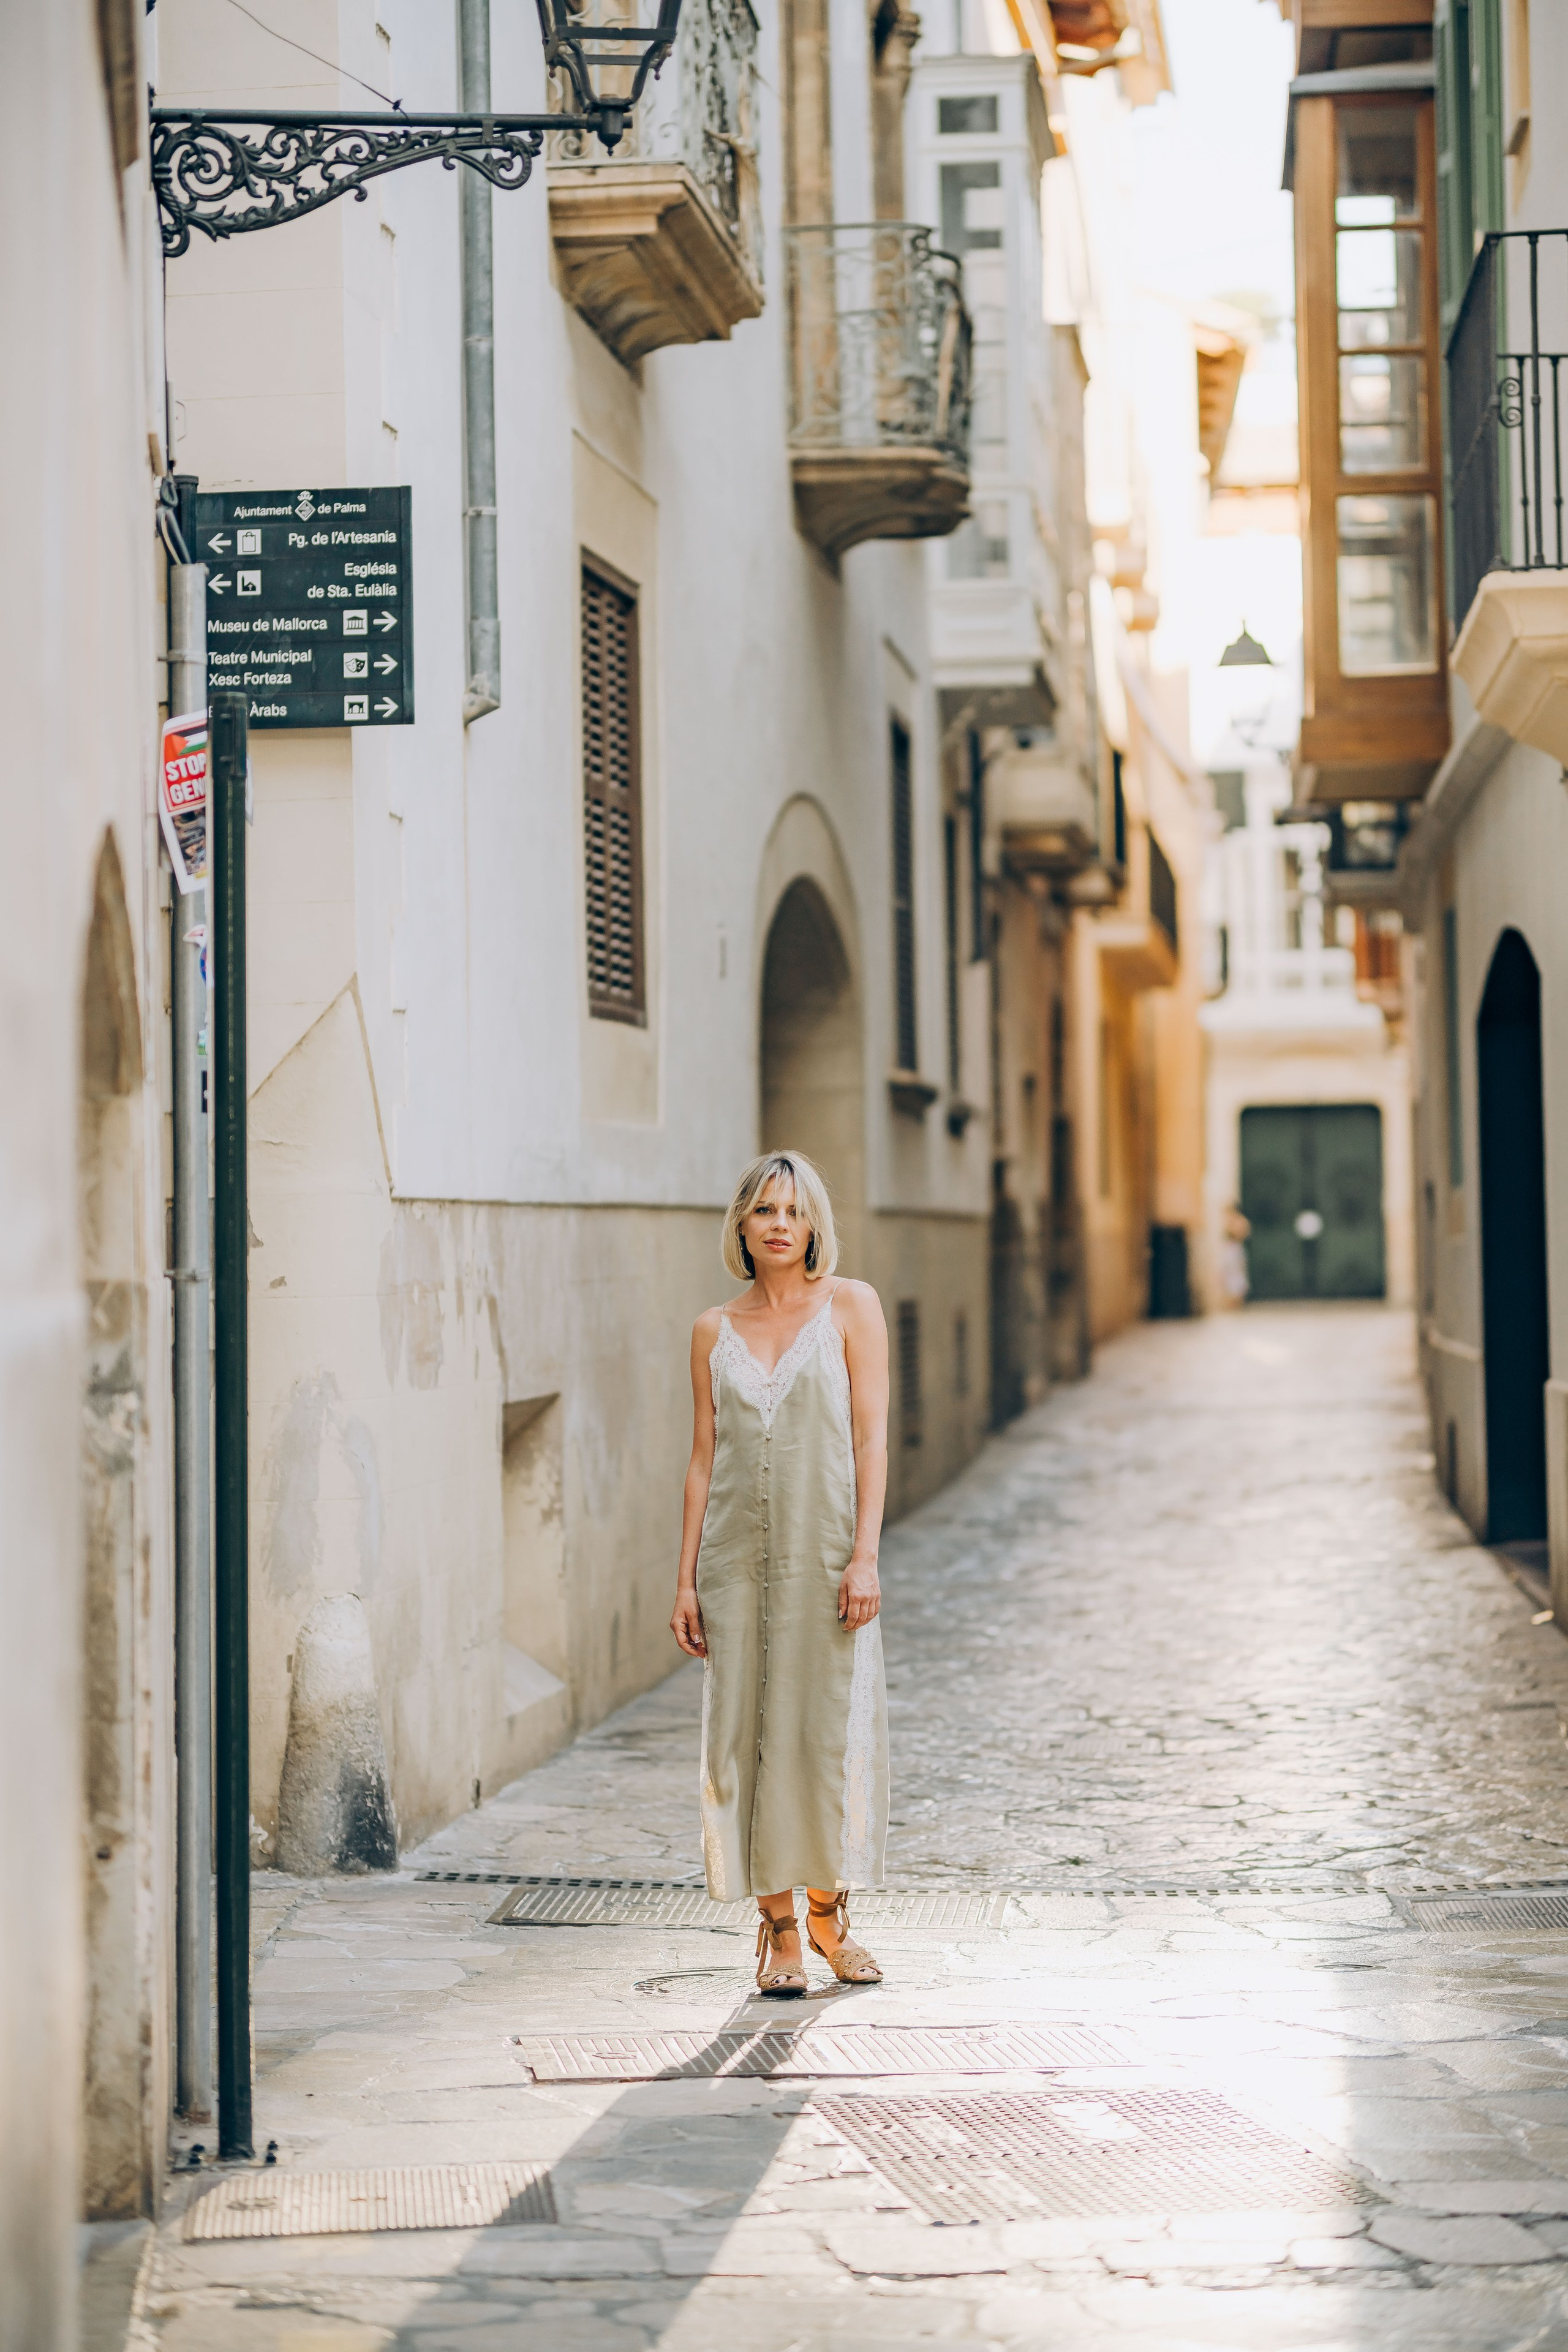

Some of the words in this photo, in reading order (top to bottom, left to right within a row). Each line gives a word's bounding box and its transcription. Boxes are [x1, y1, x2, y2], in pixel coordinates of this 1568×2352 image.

[233, 505, 293, 519] Ajuntament
[317, 503, 332, 514] de
[333, 502, 367, 514] Palma
[288, 532, 309, 549] Pg.
[311, 532, 329, 546] de
[331, 530, 398, 545] l'Artesania
[344, 562, 398, 579] Església
[307, 585, 325, 598] de
[327, 584, 353, 598] Sta.
[355, 582, 398, 598] Eulàlia
[208, 619, 250, 633] Museu
[252, 618, 270, 632] de
[273, 617, 328, 631] Mallorca
[208, 651, 249, 666] Teatre
[251, 649, 313, 666] Municipal
[208, 672, 241, 687] Xesc
[244, 671, 293, 686] Forteza
[249, 701, 288, 718] Àrabs
[165, 752, 206, 782] STOP
